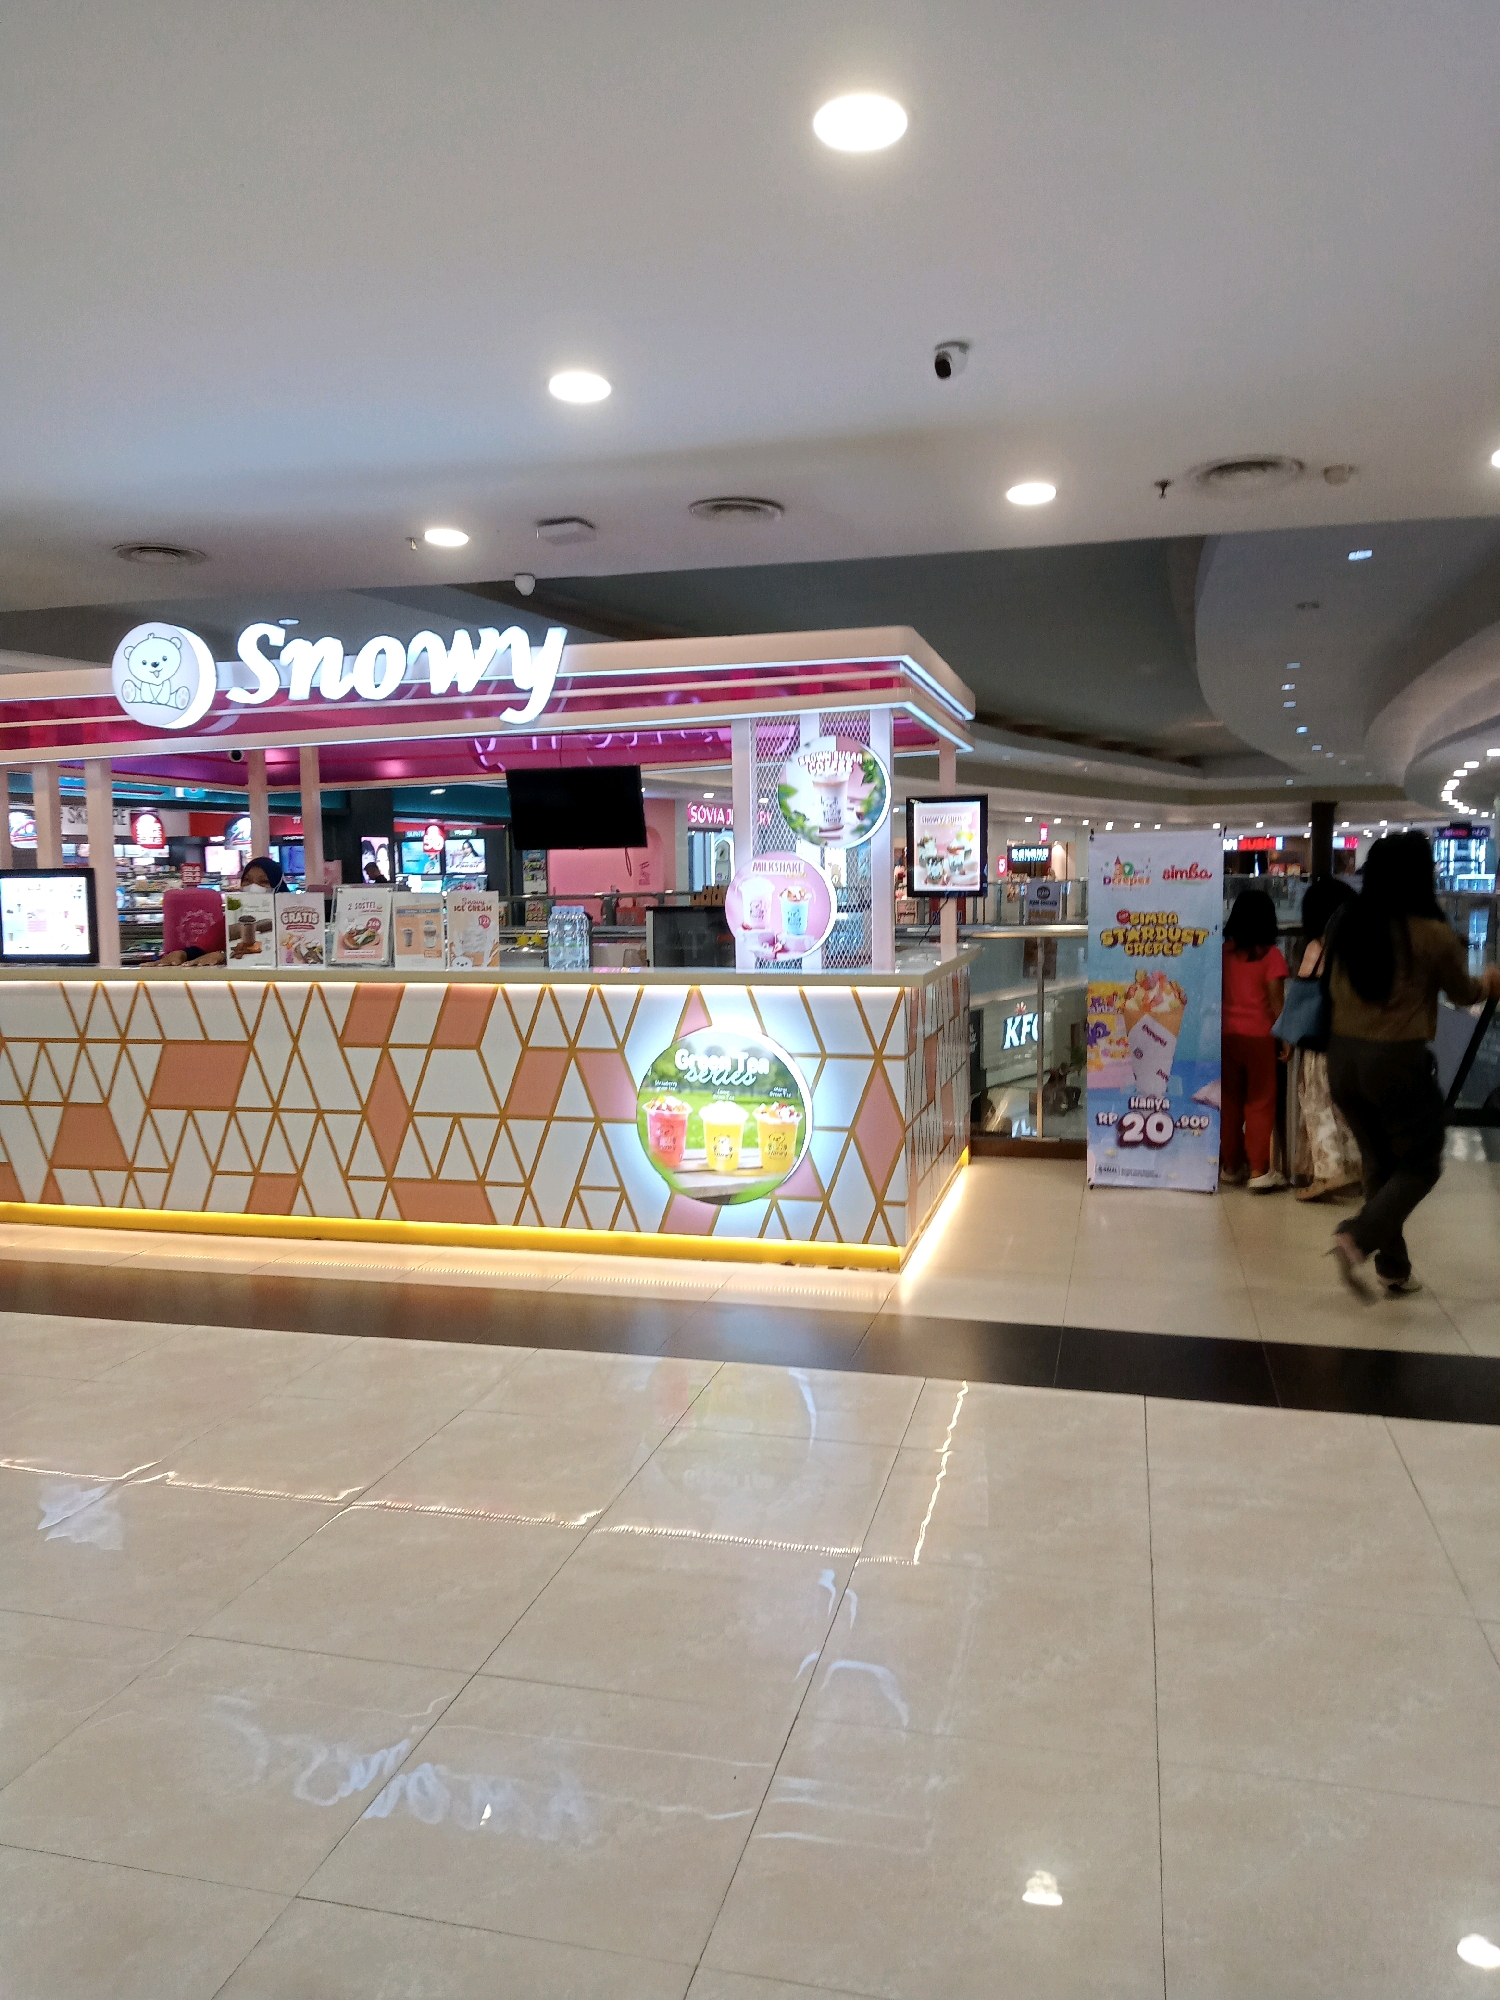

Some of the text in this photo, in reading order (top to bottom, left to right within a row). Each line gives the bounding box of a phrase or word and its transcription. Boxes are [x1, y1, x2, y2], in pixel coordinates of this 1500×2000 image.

[226, 622, 567, 725] Snowy
[690, 805, 725, 824] SOVIA
[752, 861, 805, 873] MILKSHAKE
[1162, 863, 1213, 881] simba
[281, 911, 320, 925] GRATIS
[1100, 926, 1209, 947] STARDUST
[675, 1049, 770, 1075] Green Tea
[684, 1066, 757, 1086] series
[1129, 1097, 1170, 1112] Hanya
[1117, 1111, 1174, 1149] 20
